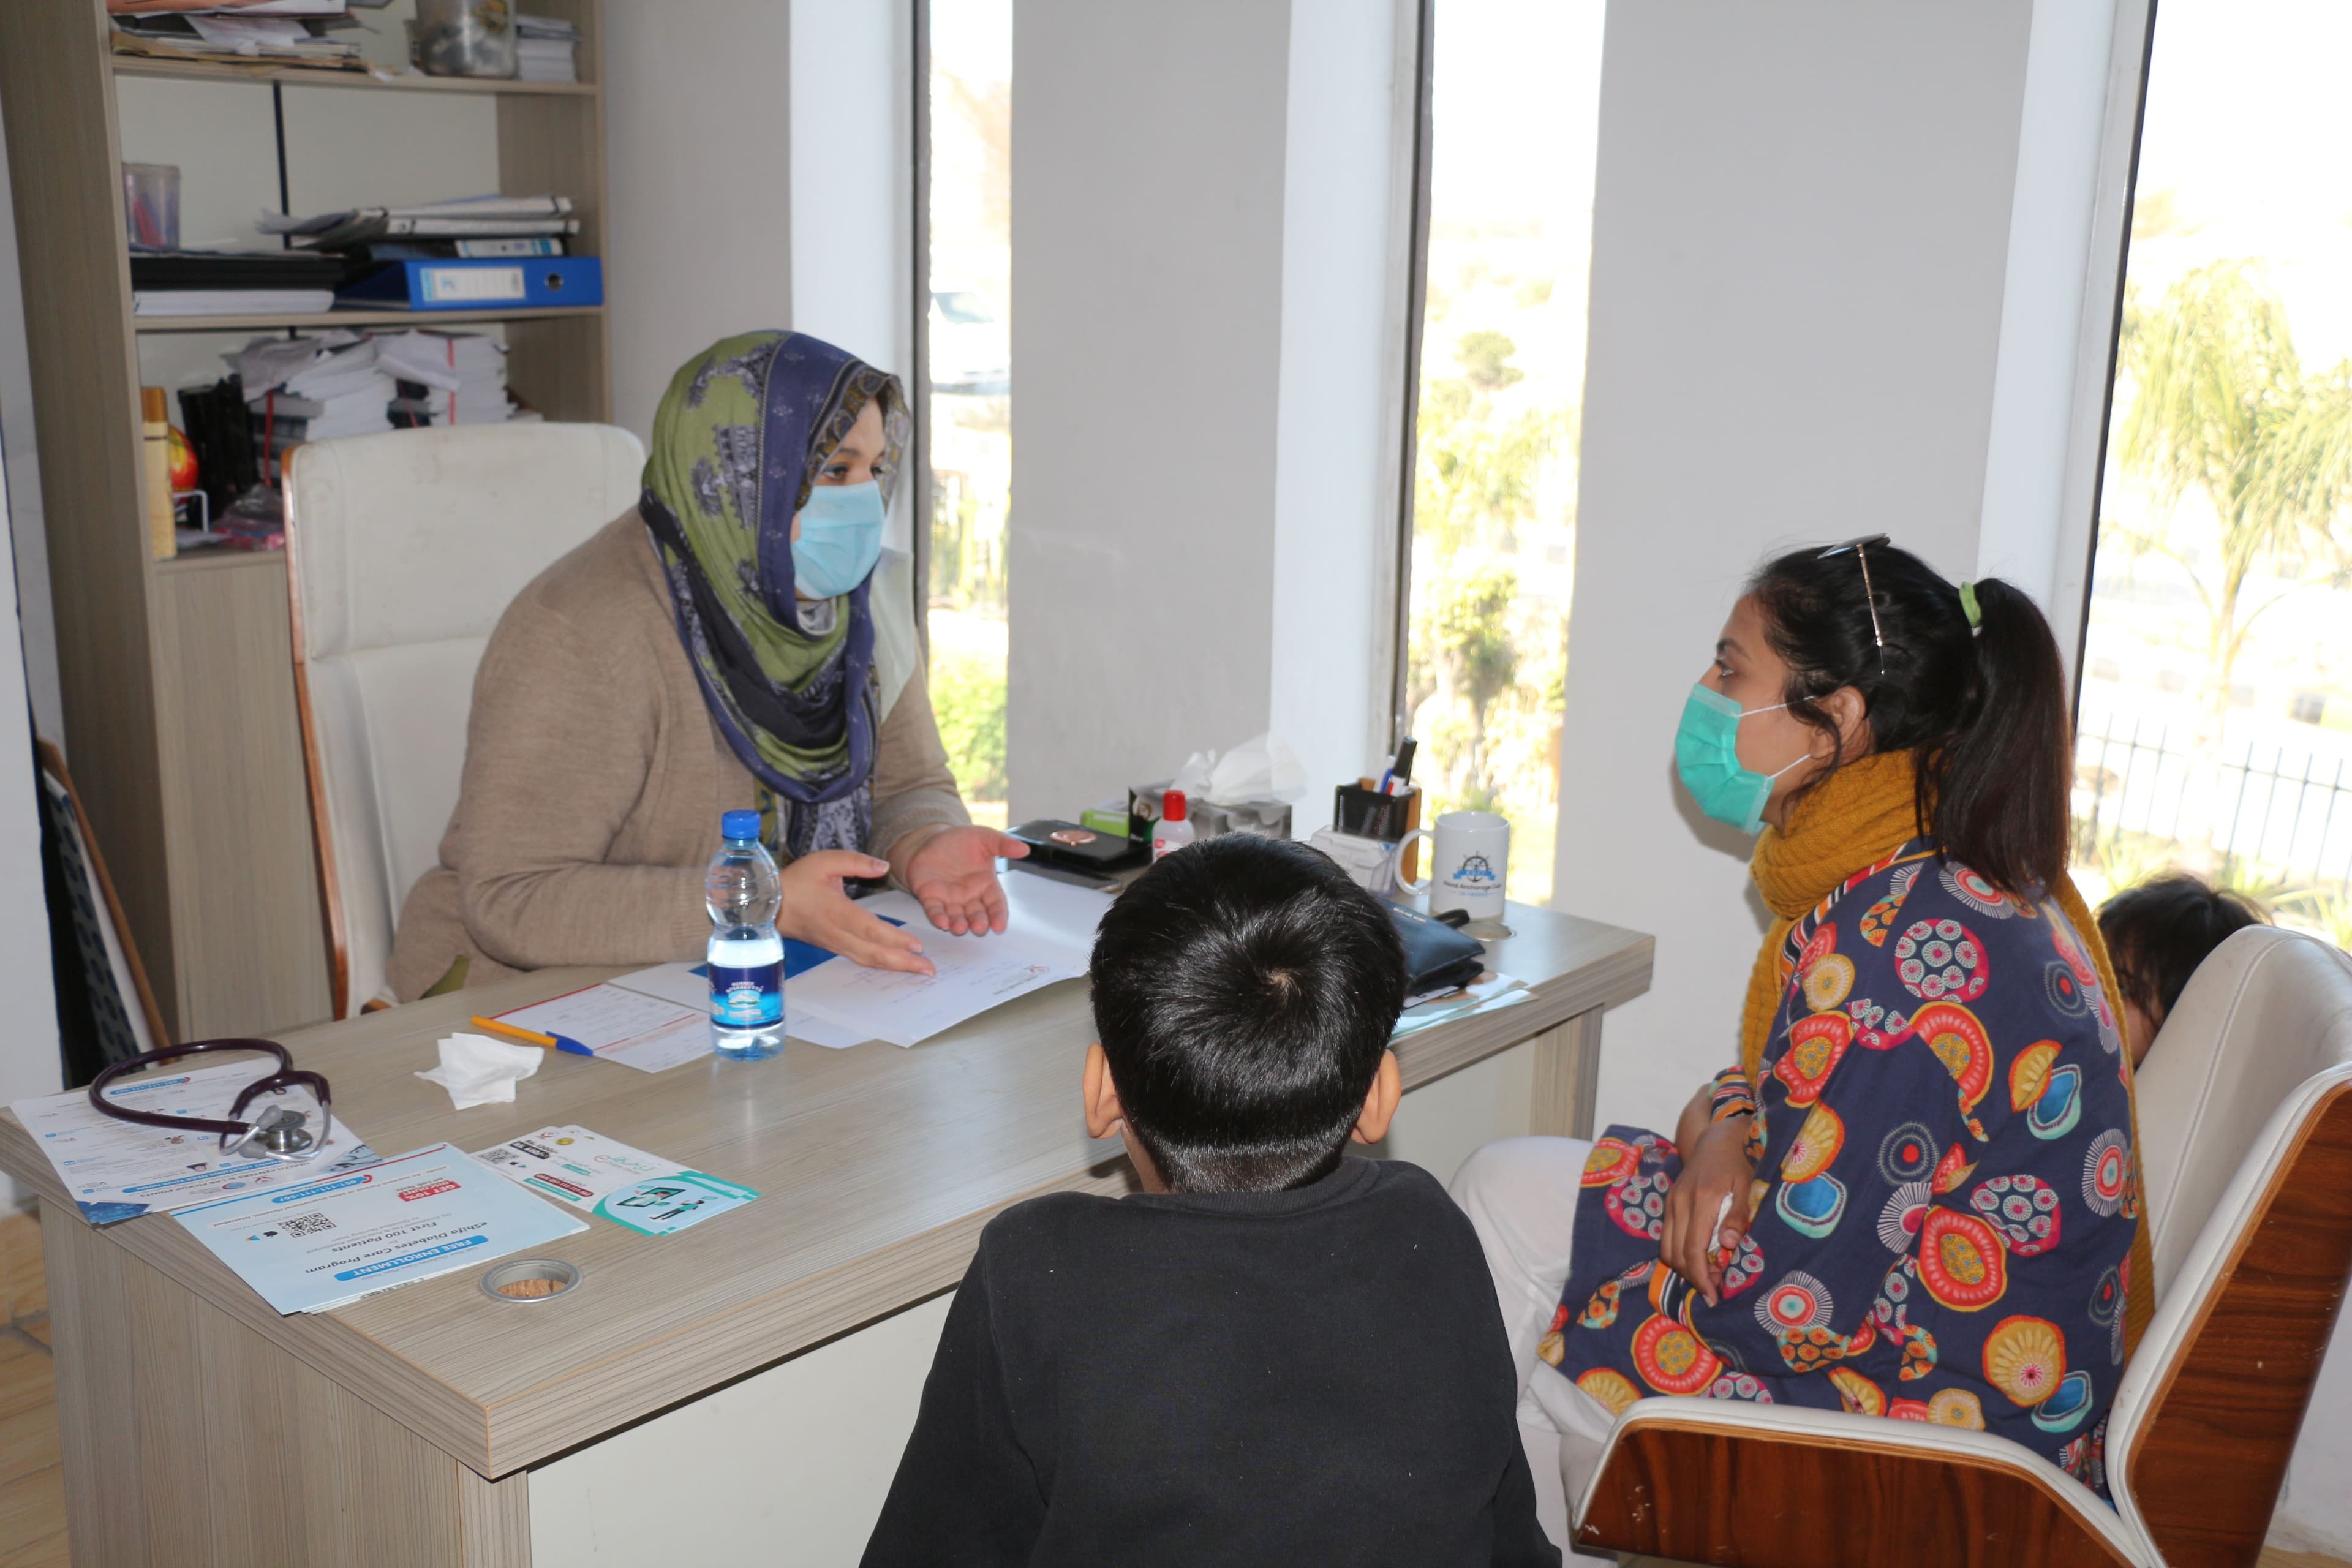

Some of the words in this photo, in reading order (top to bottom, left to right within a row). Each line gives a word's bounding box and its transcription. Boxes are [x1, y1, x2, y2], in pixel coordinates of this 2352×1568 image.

[209, 1165, 252, 1176] LOCATIONS
[238, 1169, 275, 1178] CENTERS
[175, 1182, 207, 1191] PICKUP
[279, 1180, 356, 1201] 051-111-111-567
[402, 1181, 448, 1195] DISCOUNT
[434, 1184, 455, 1193] GET
[411, 1221, 437, 1231] First
[450, 1221, 487, 1234] eShifa
[385, 1229, 407, 1238] 100
[332, 1236, 382, 1251] Patients
[394, 1232, 447, 1248] Diabetes
[441, 1240, 472, 1251] FREE
[364, 1248, 392, 1257] Care
[306, 1256, 360, 1273] Program
[354, 1248, 439, 1275] ENROLLMENT
[418, 1254, 448, 1264] Diabetes
